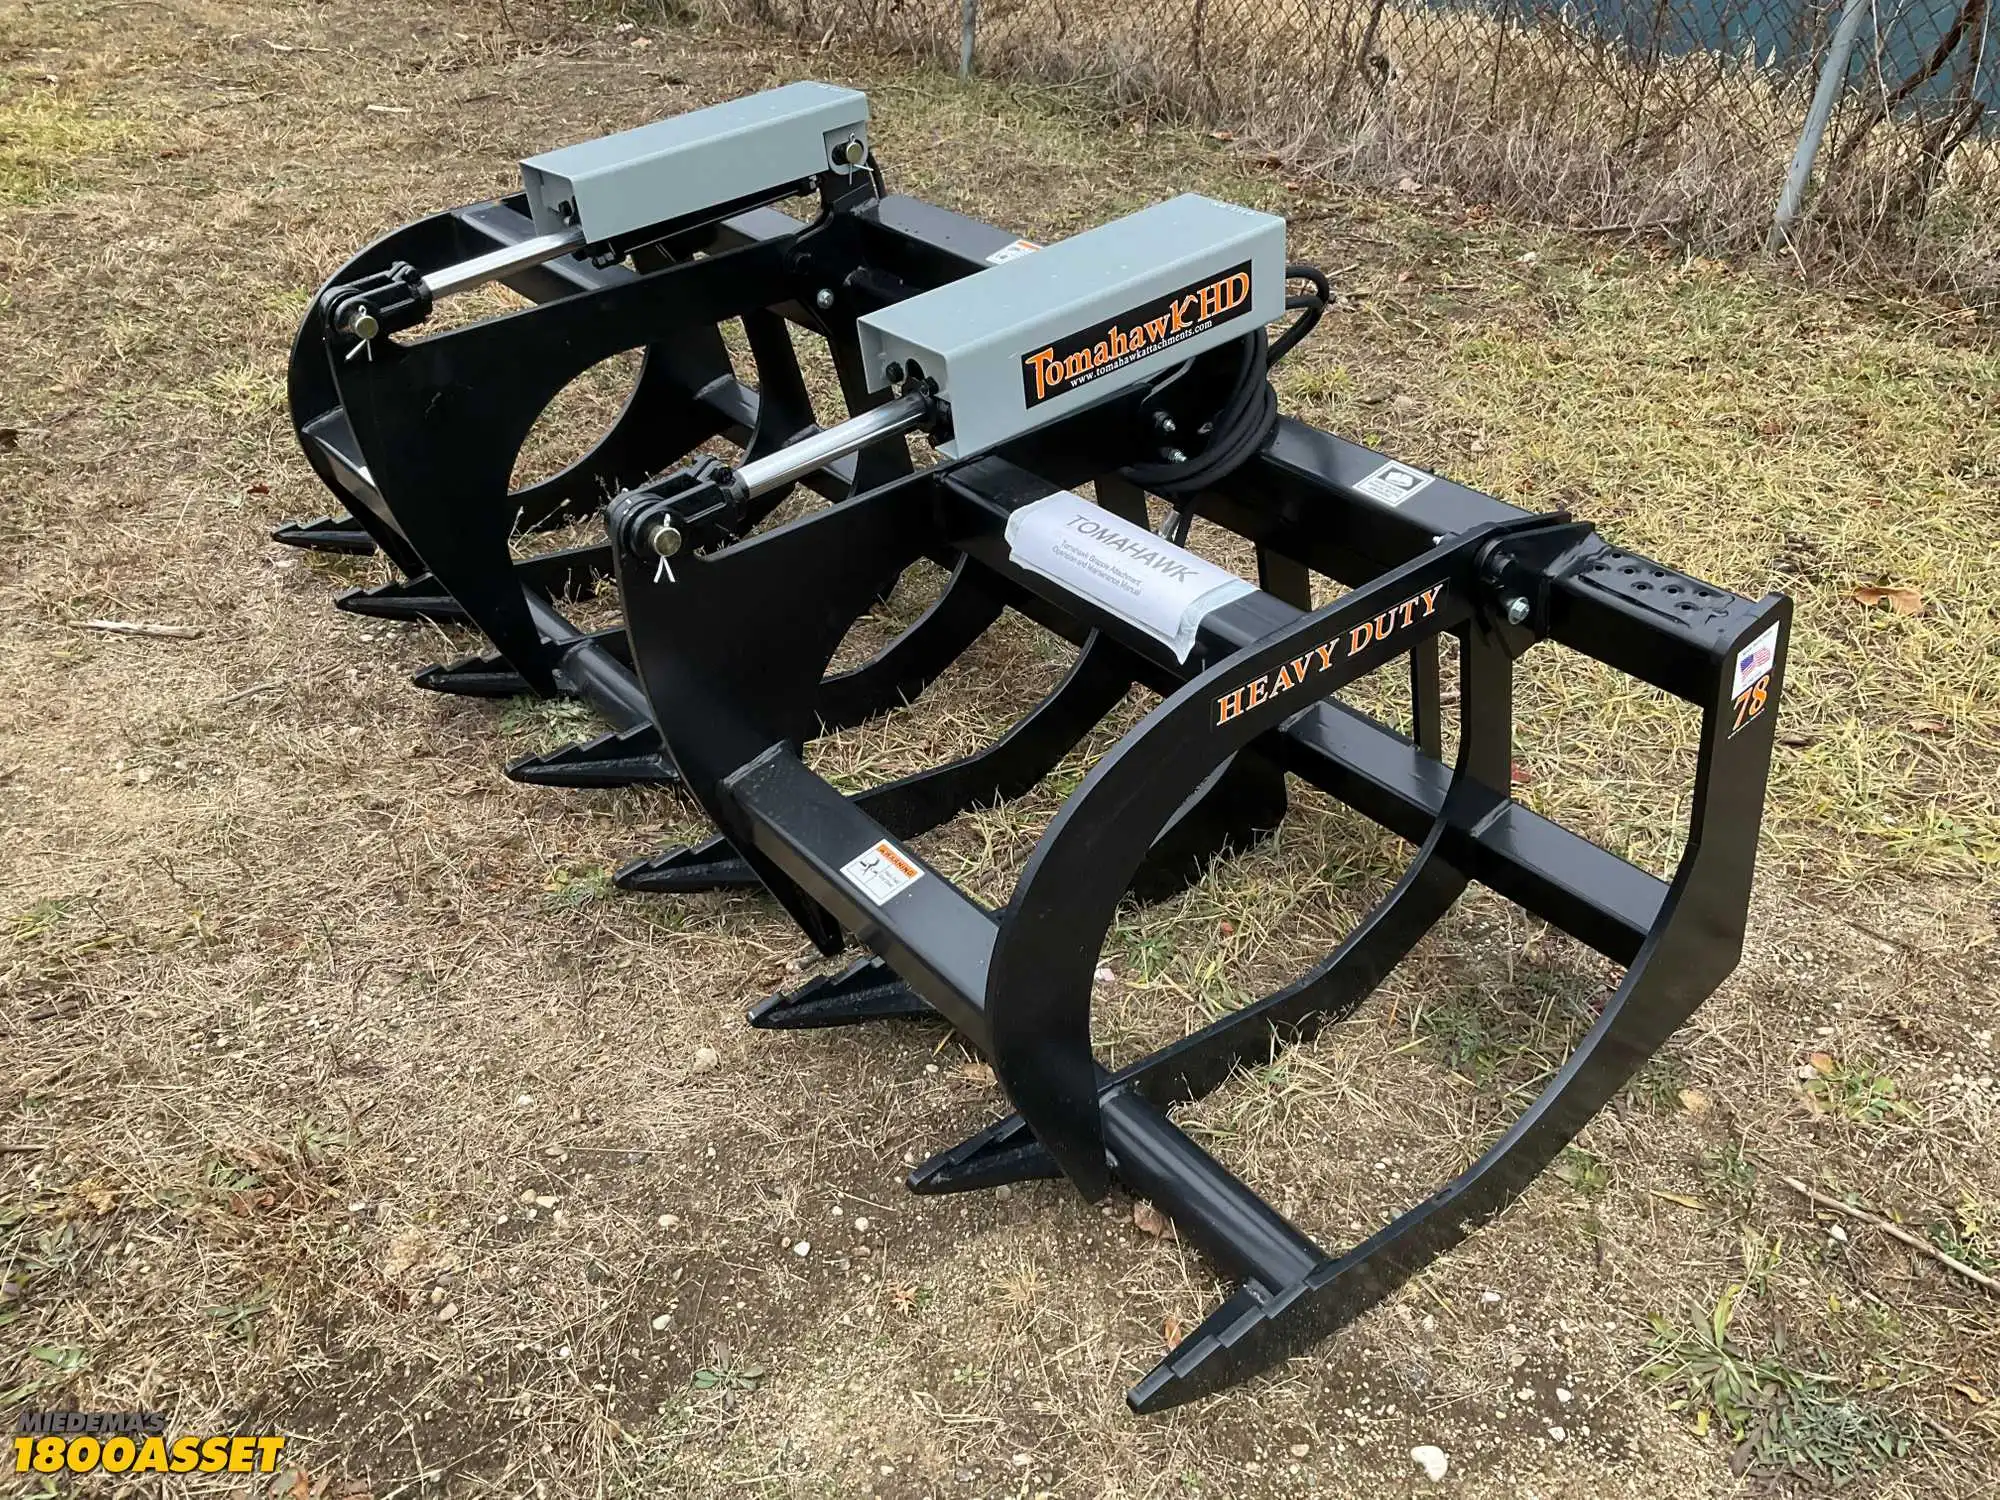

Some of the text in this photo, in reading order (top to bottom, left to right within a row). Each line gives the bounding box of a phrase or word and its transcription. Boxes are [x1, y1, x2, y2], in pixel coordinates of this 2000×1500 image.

[1197, 271, 1250, 323] HD
[1070, 319, 1213, 388] www.tomahawkattachments.com
[1065, 514, 1199, 583] TOMAHAWK
[1216, 583, 1444, 727] HEAVY DUTY
[1733, 674, 1770, 731] 78
